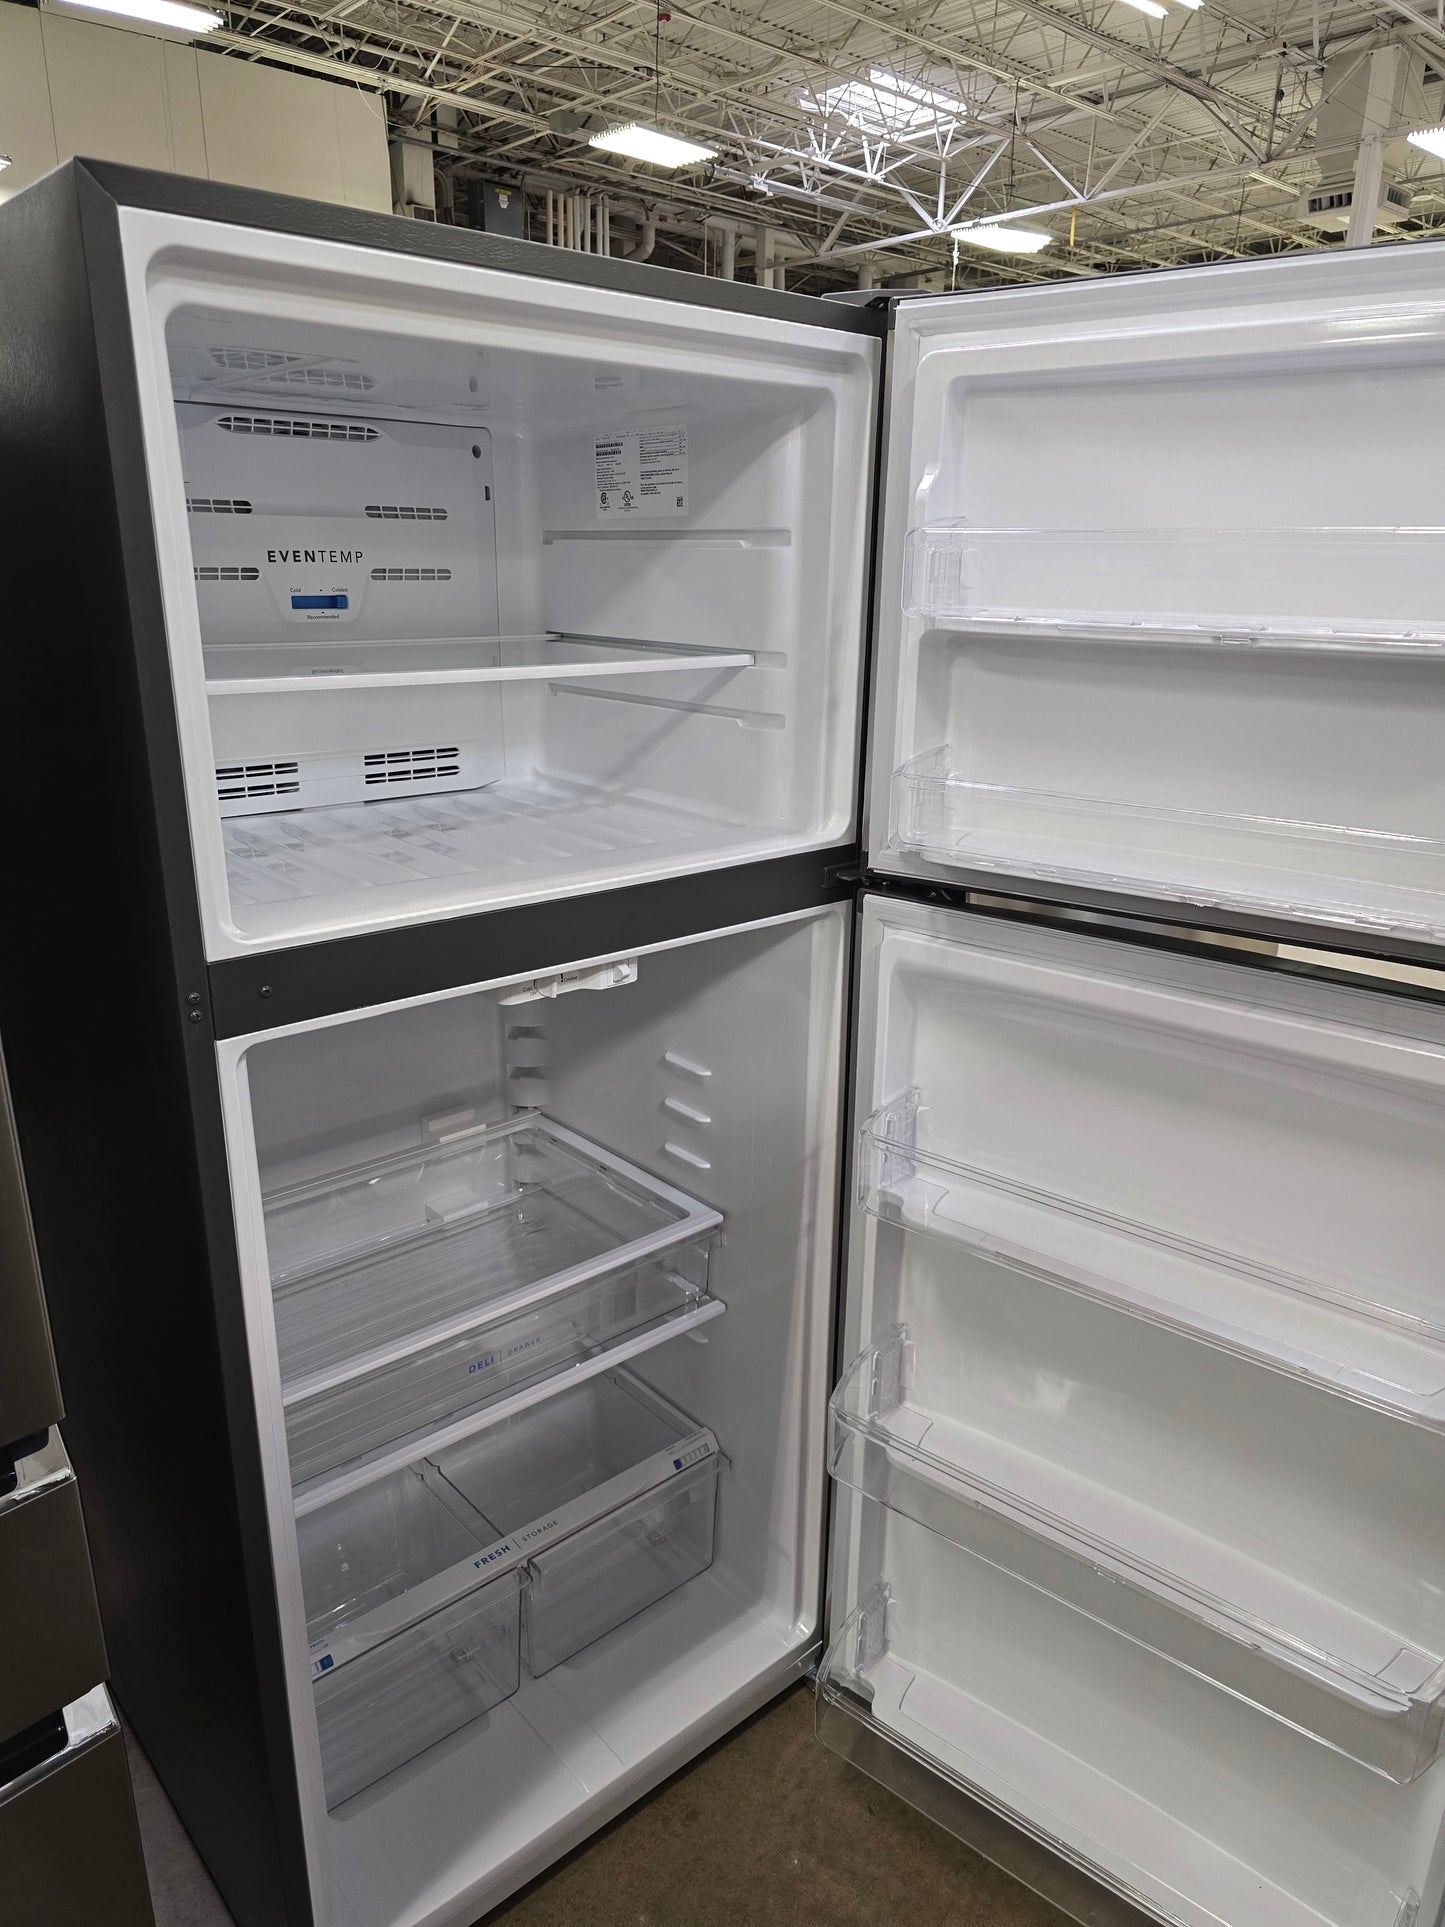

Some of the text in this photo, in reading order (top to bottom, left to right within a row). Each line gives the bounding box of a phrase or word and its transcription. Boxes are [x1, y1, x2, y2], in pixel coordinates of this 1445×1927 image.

[267, 550, 363, 563] EVENTEMP
[468, 1336, 541, 1374] DELI DRAWER
[473, 1520, 558, 1568] FRESH STORAGE
